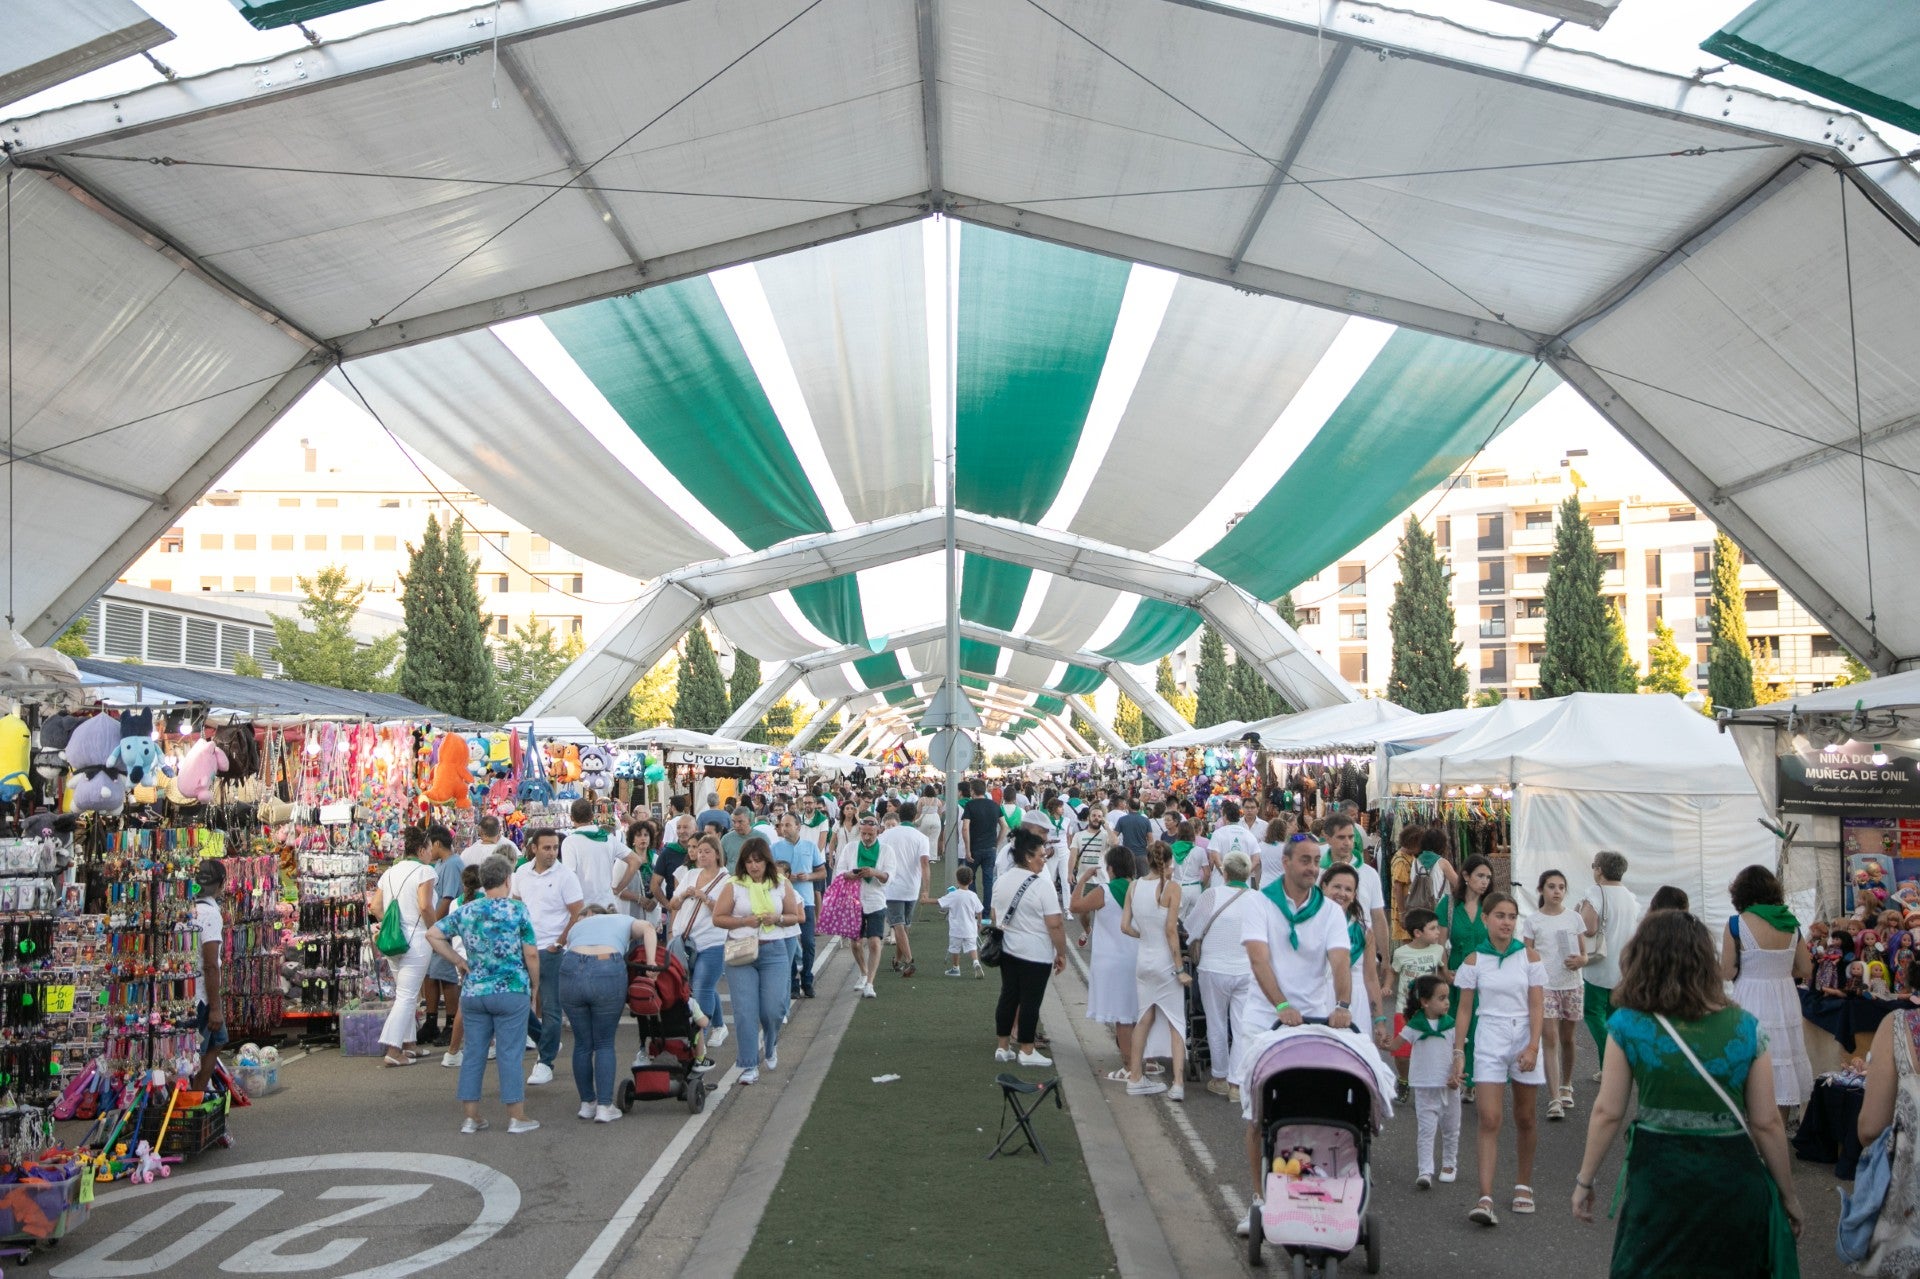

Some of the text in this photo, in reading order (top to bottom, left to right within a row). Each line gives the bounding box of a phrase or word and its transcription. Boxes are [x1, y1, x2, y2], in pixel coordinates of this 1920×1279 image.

[1852, 754, 1894, 765] D'OL
[1805, 767, 1909, 781] MUÑECA DE ONIL
[48, 1183, 434, 1279] 20
